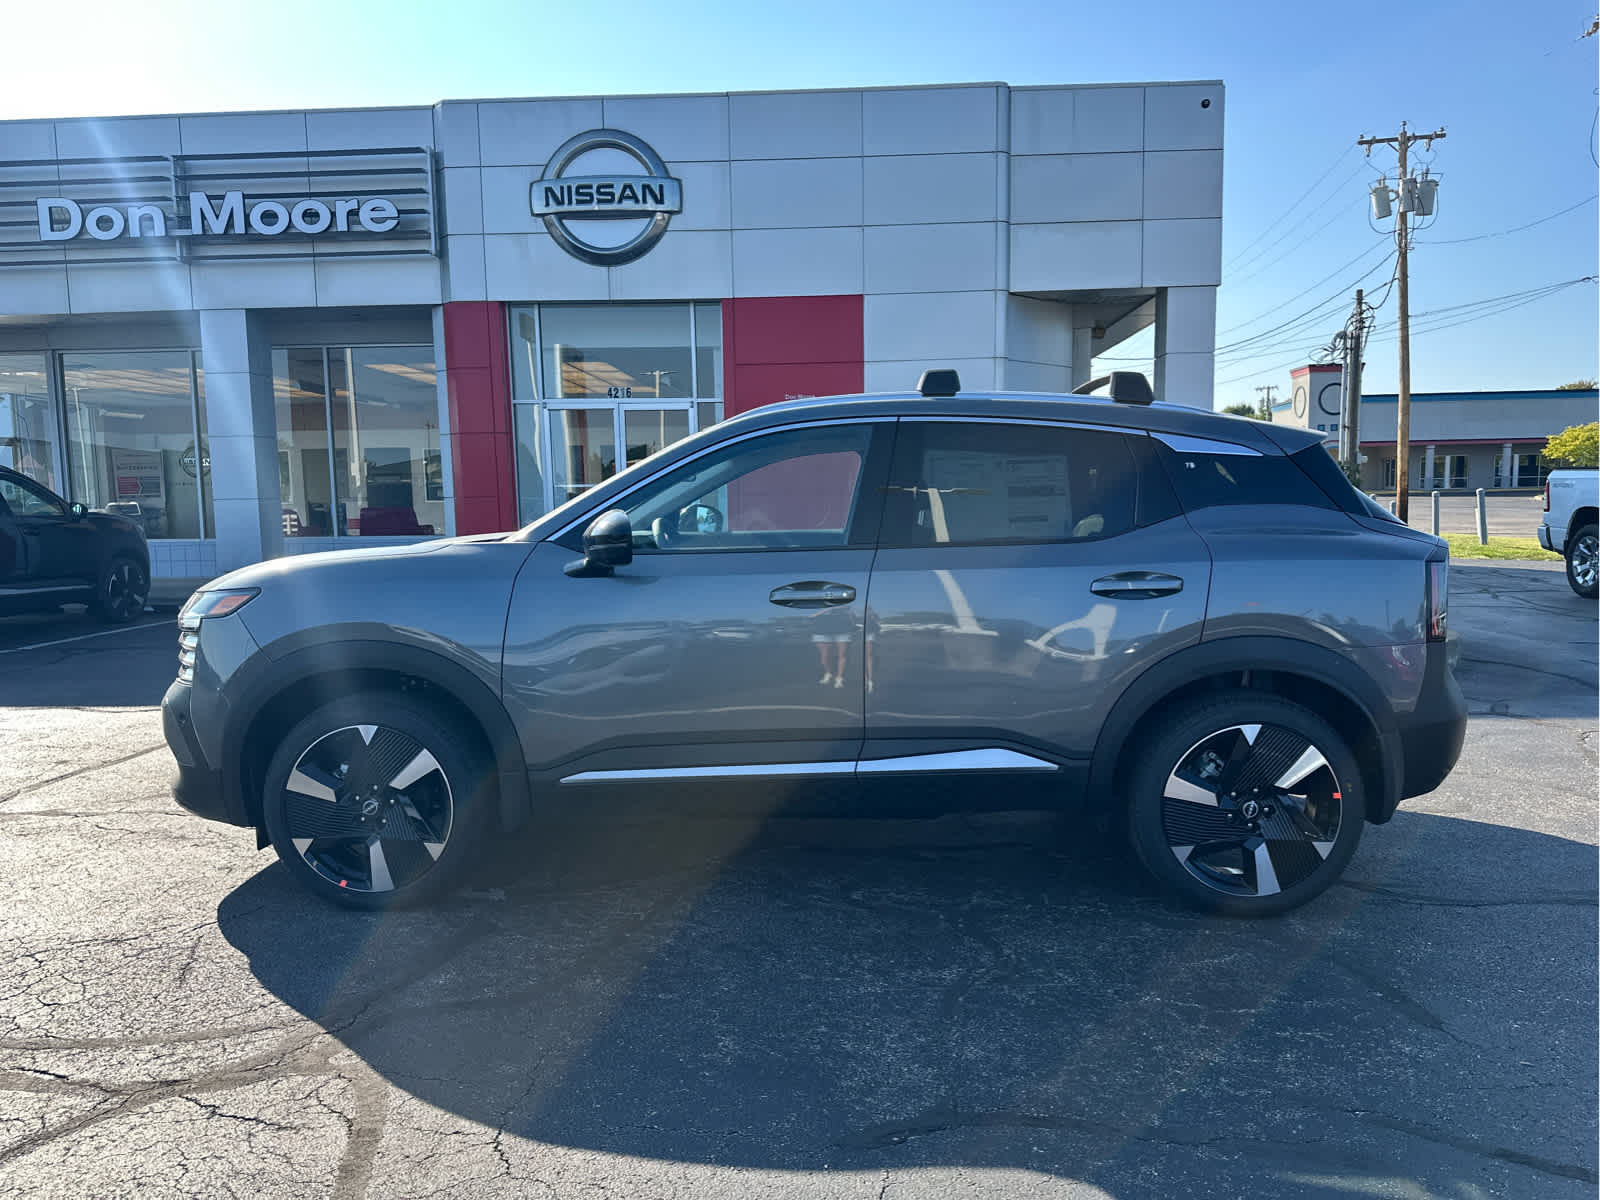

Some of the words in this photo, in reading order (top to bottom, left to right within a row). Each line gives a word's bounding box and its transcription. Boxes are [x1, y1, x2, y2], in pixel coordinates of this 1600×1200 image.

[544, 183, 665, 207] NISSAN
[37, 197, 167, 241] Don
[189, 191, 401, 235] Moore
